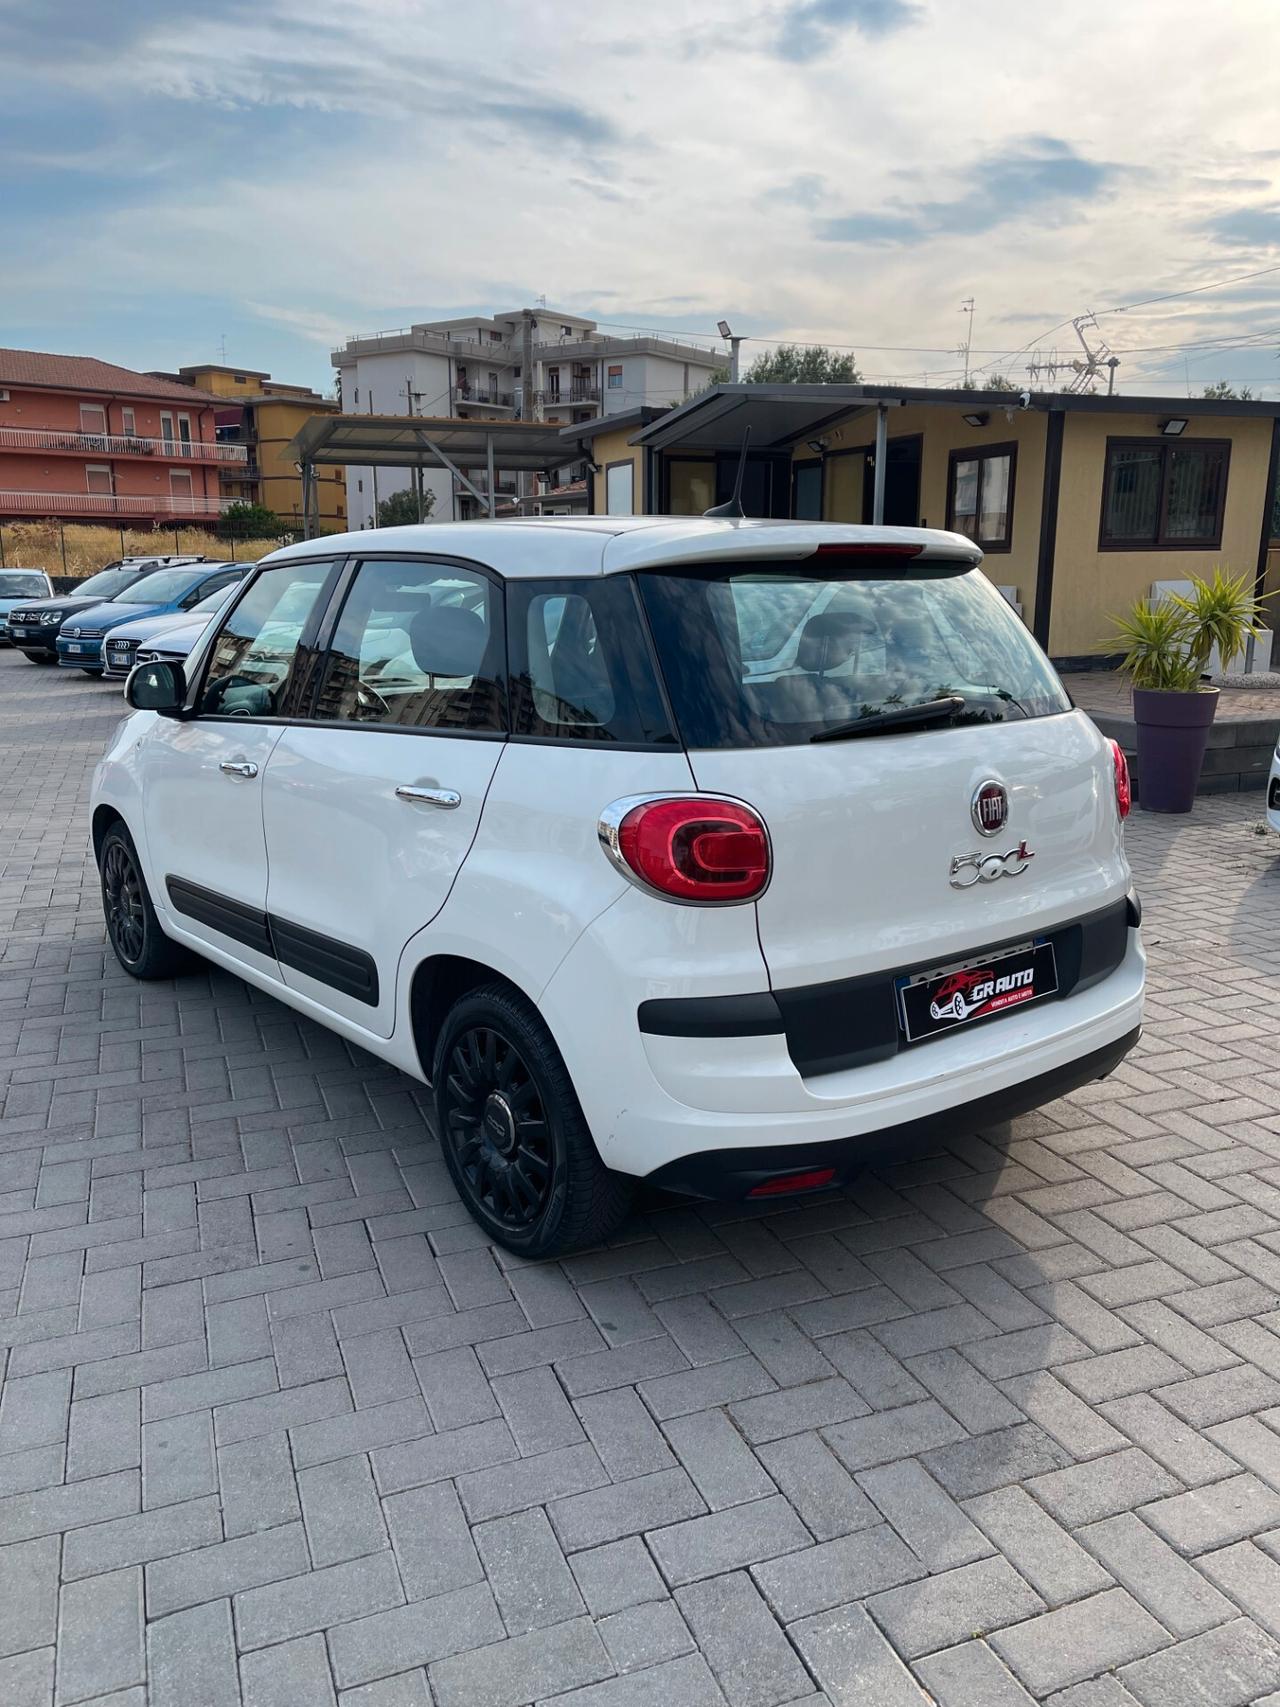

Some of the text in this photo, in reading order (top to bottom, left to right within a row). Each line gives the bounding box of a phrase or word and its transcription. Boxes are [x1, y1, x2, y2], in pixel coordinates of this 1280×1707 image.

[982, 796, 1003, 822] FIAT
[972, 968, 1034, 1001] GR AUTO
[1008, 994, 1018, 1002] AUTO
